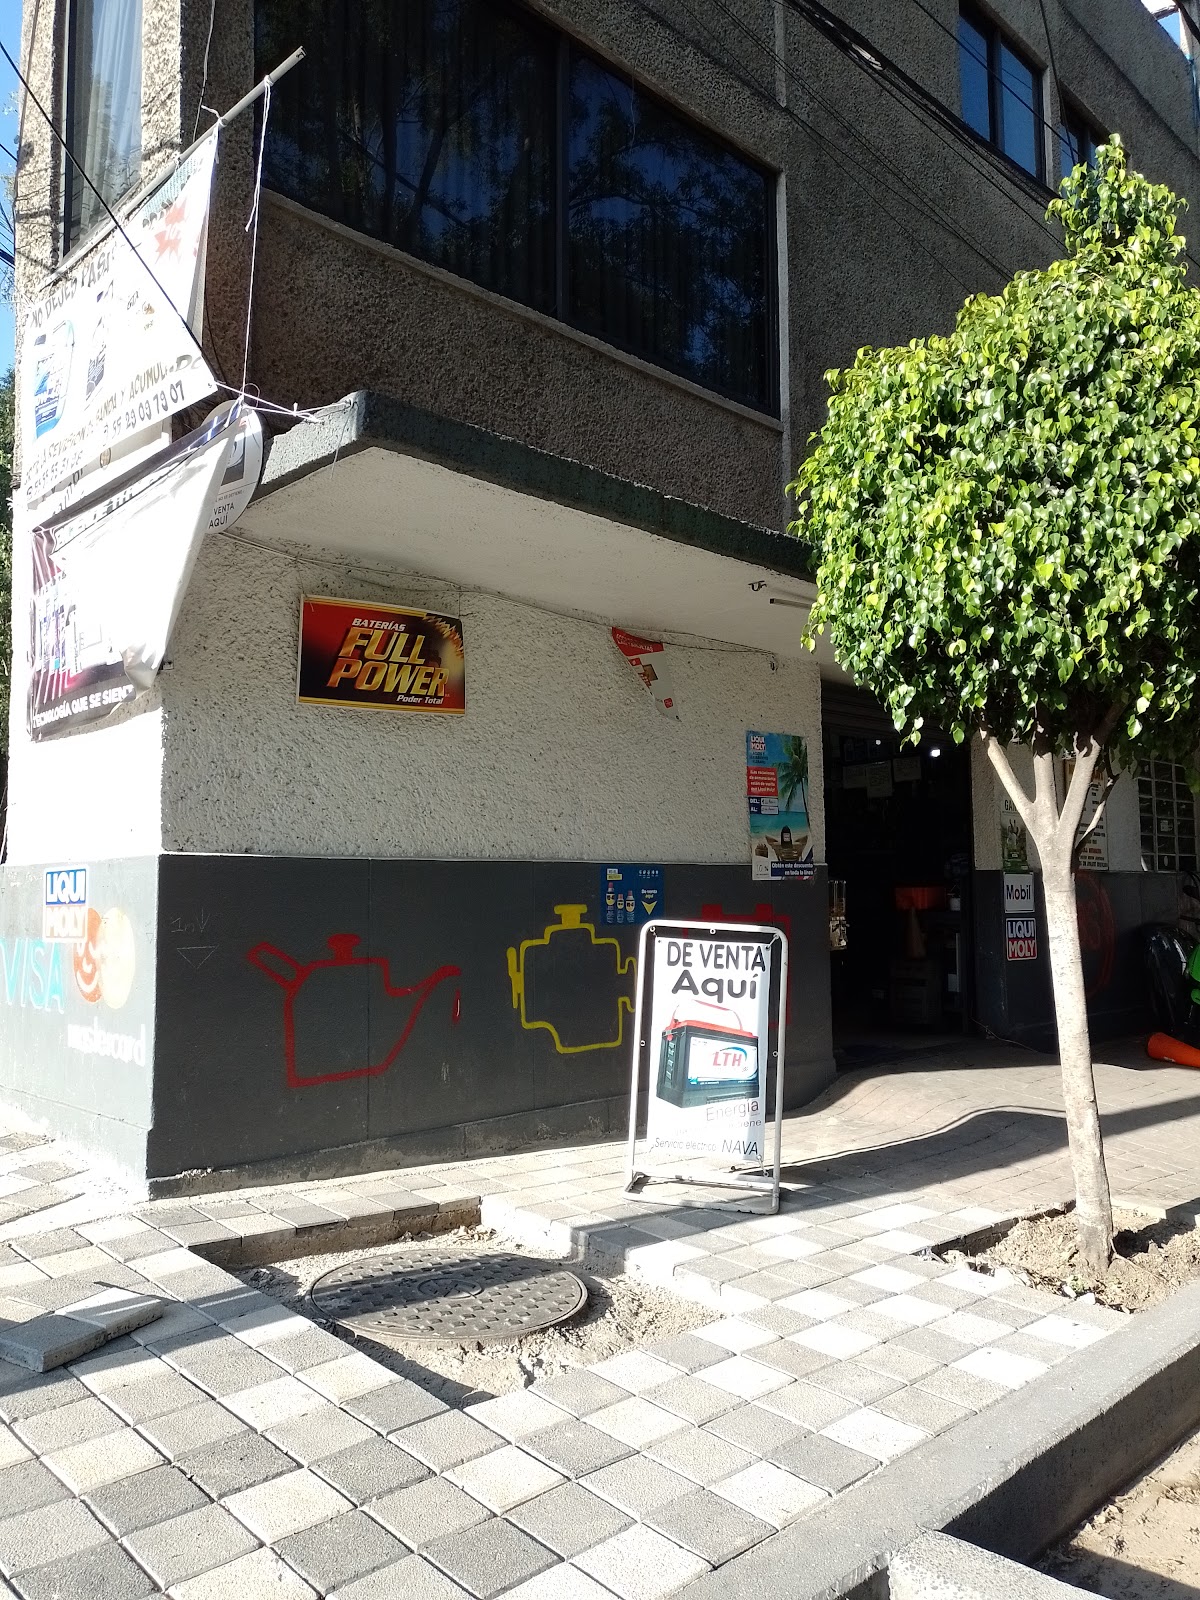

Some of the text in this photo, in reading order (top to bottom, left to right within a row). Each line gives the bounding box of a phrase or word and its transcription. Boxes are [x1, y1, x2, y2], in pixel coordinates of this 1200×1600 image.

[30, 306, 44, 329] NO
[45, 275, 78, 320] DEJES
[138, 400, 152, 421] 09
[153, 390, 168, 415] 79
[170, 379, 185, 404] 07
[208, 512, 229, 530] AQUÍ
[213, 502, 235, 516] VENTA
[351, 618, 407, 632] BATERÍAS
[338, 627, 426, 665] FULL
[326, 657, 450, 698] POWER
[33, 684, 134, 729] TECNOLOGÍA QUE SE SIENT
[396, 694, 444, 706] Poder Total
[46, 868, 87, 904] LIQUI
[1006, 884, 1031, 900] Mobil
[46, 905, 87, 939] MOLY
[1007, 920, 1035, 938] LIQUI
[667, 941, 767, 973] DE VENTA
[1008, 939, 1036, 958] MOLY
[0, 938, 65, 1014] VISA
[671, 969, 760, 1004] Aquí
[712, 1051, 744, 1067] LTH
[705, 1098, 759, 1122] Energía
[654, 1137, 684, 1150] Servicio
[721, 1138, 759, 1156] NAVA
